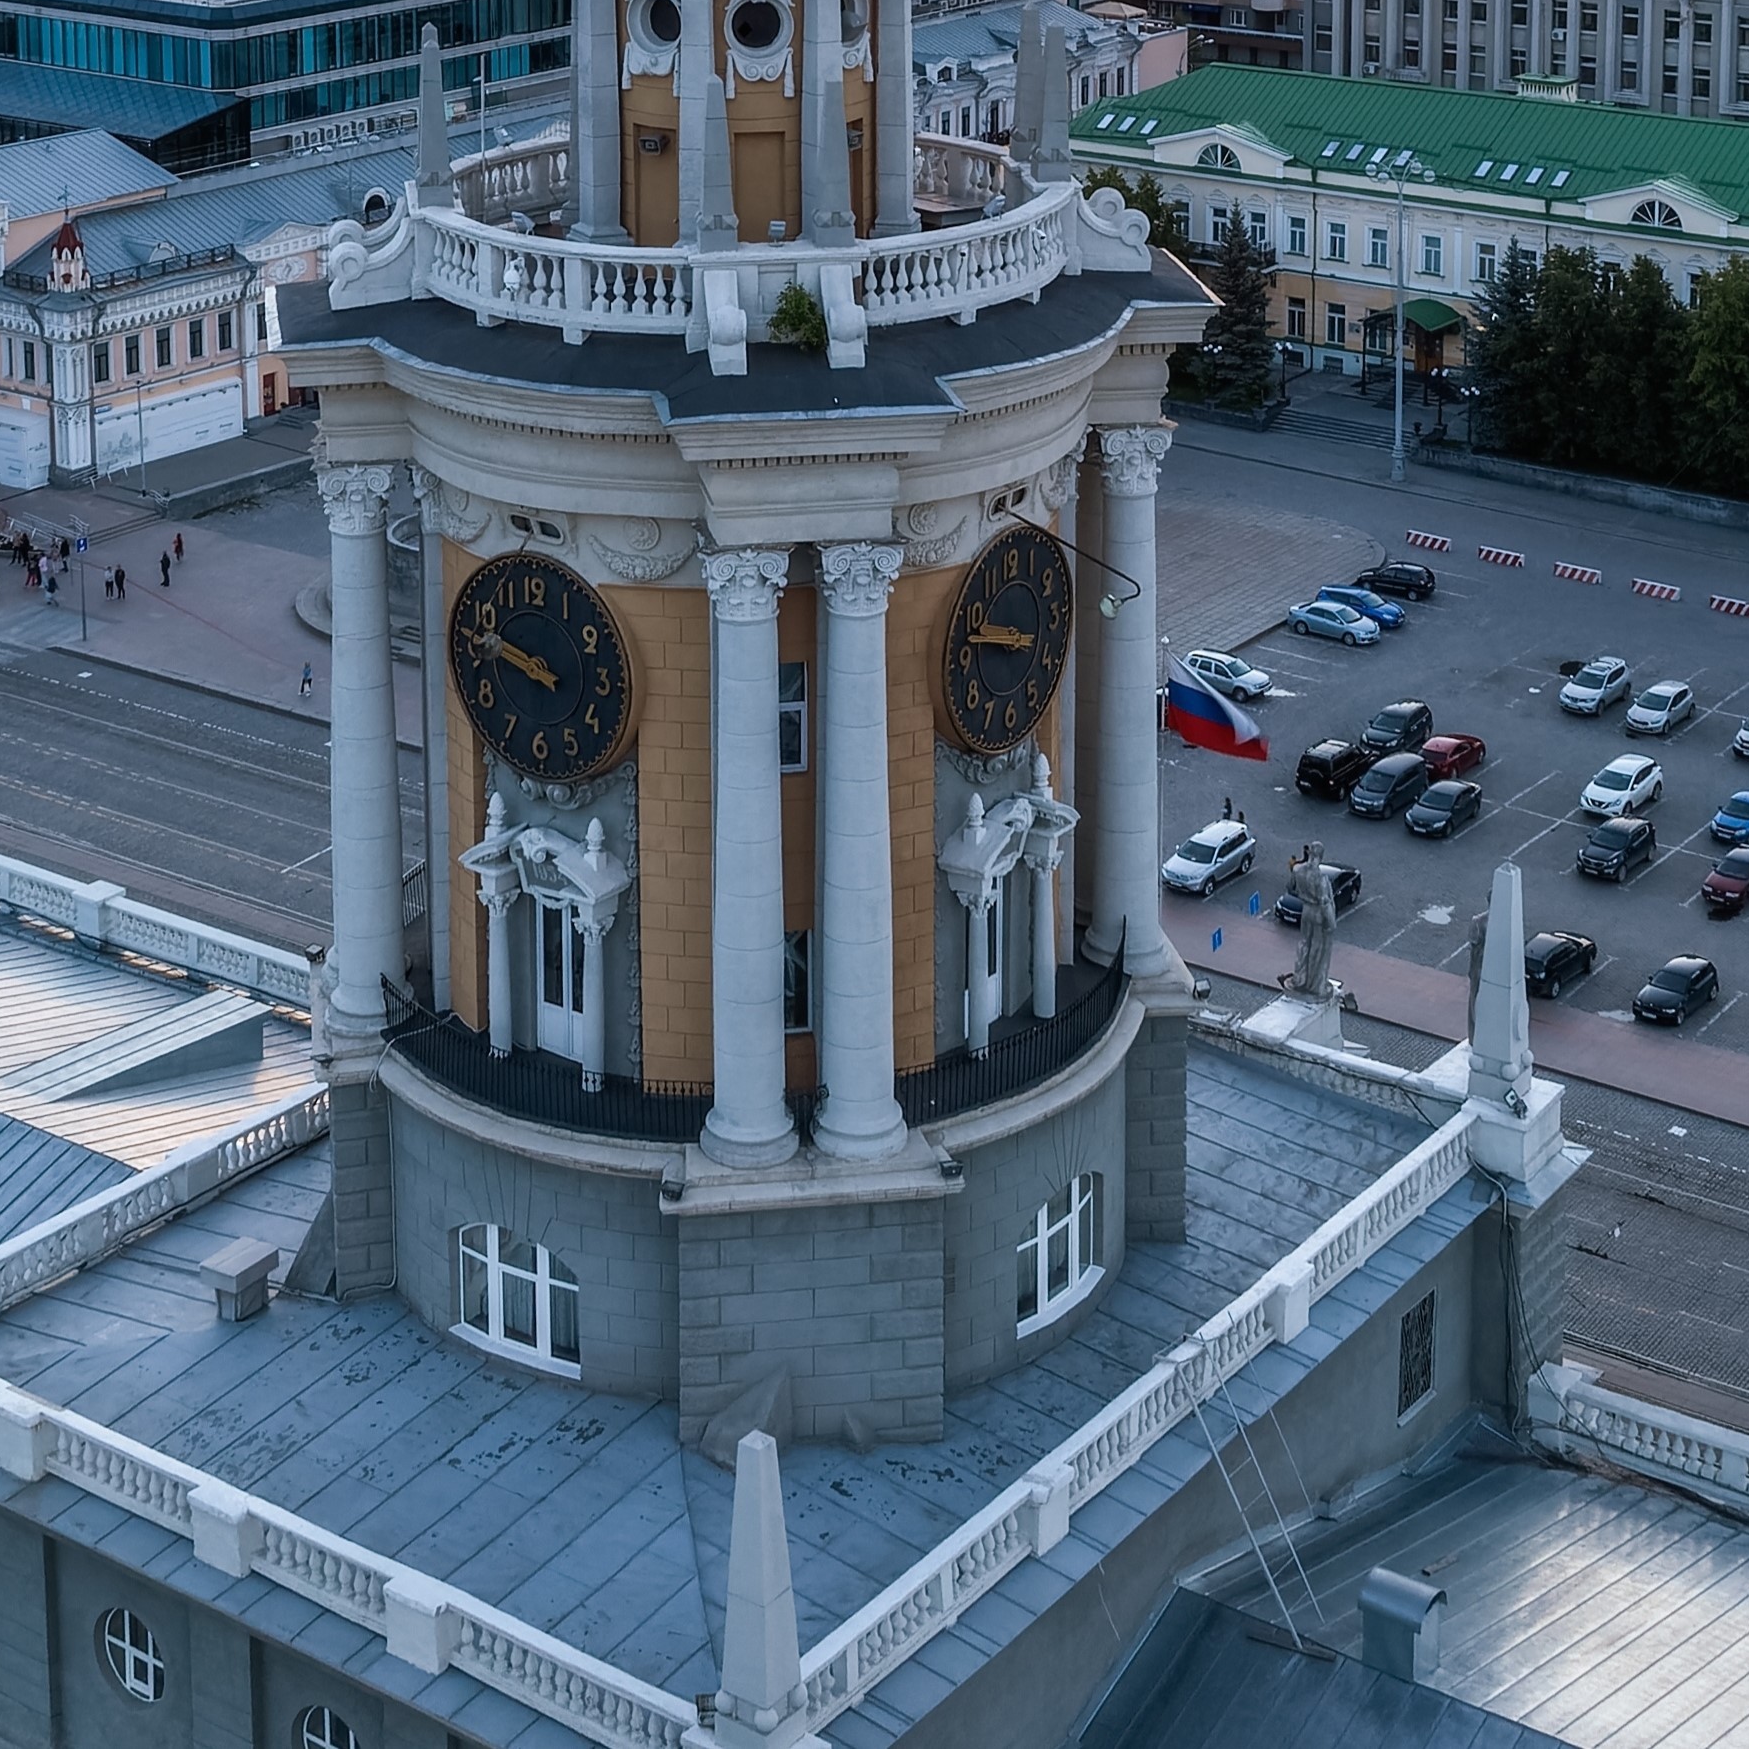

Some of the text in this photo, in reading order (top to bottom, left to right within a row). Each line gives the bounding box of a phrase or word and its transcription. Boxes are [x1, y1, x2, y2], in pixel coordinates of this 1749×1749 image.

[1003, 548, 1018, 581] 12
[1029, 548, 1035, 577] 1
[498, 580, 514, 608] 11
[524, 575, 546, 607] 12
[985, 566, 997, 599] 11
[1042, 567, 1053, 597] 2
[475, 600, 496, 629] 10
[562, 591, 569, 620] 1
[966, 601, 983, 633] 10
[1048, 601, 1060, 631] 3
[582, 624, 598, 654] 2
[959, 645, 972, 675] 9
[1042, 642, 1052, 671] 4
[478, 678, 495, 709] 8
[595, 666, 611, 697] 3
[966, 679, 979, 710] 8
[1027, 679, 1038, 708] 5
[504, 713, 518, 739] 7
[584, 703, 600, 735] 4
[984, 699, 996, 730] 7
[1004, 699, 1017, 729] 6
[532, 731, 549, 760] 6
[563, 728, 579, 757] 5
